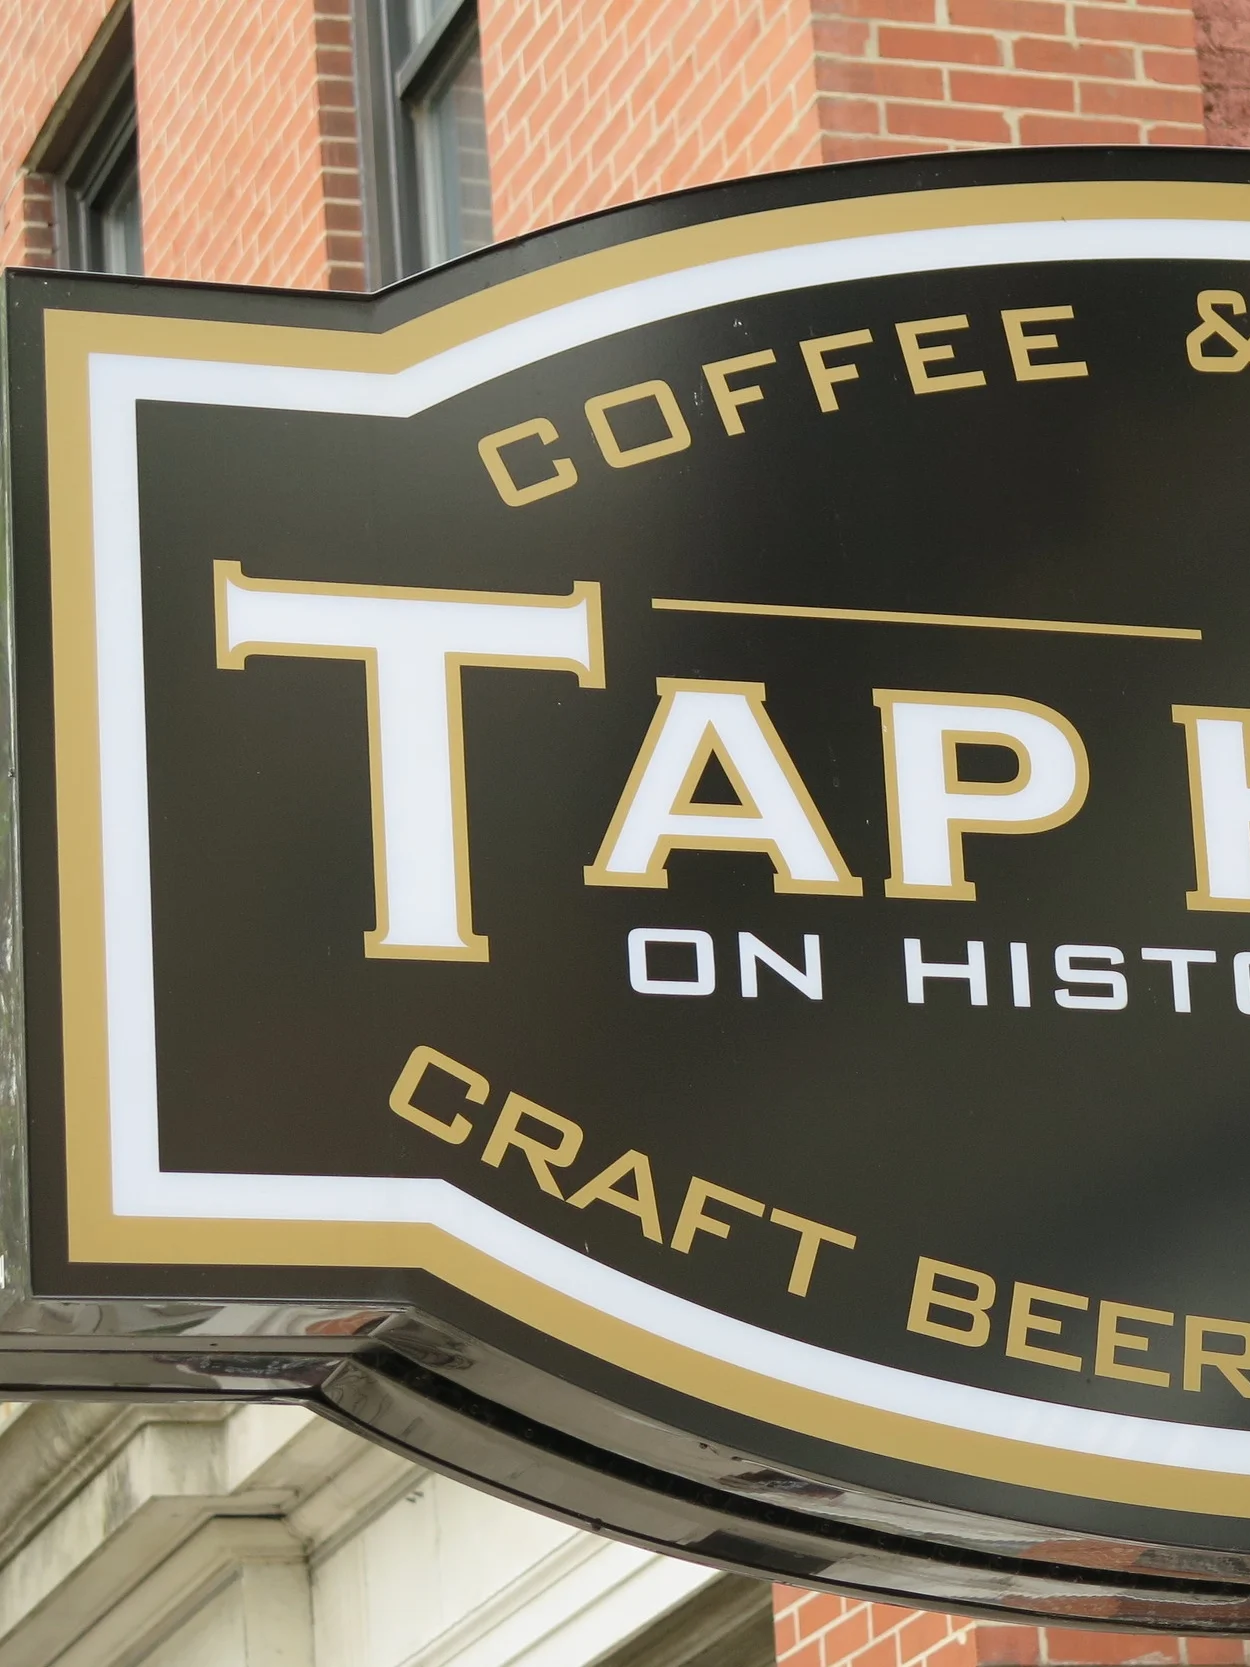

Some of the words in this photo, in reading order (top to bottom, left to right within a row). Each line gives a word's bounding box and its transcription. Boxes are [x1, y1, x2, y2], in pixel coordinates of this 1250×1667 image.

[478, 306, 1088, 507] COFFEE
[213, 560, 1089, 962] TAP
[628, 928, 822, 1000] ON
[389, 1046, 856, 1297] CRAFT
